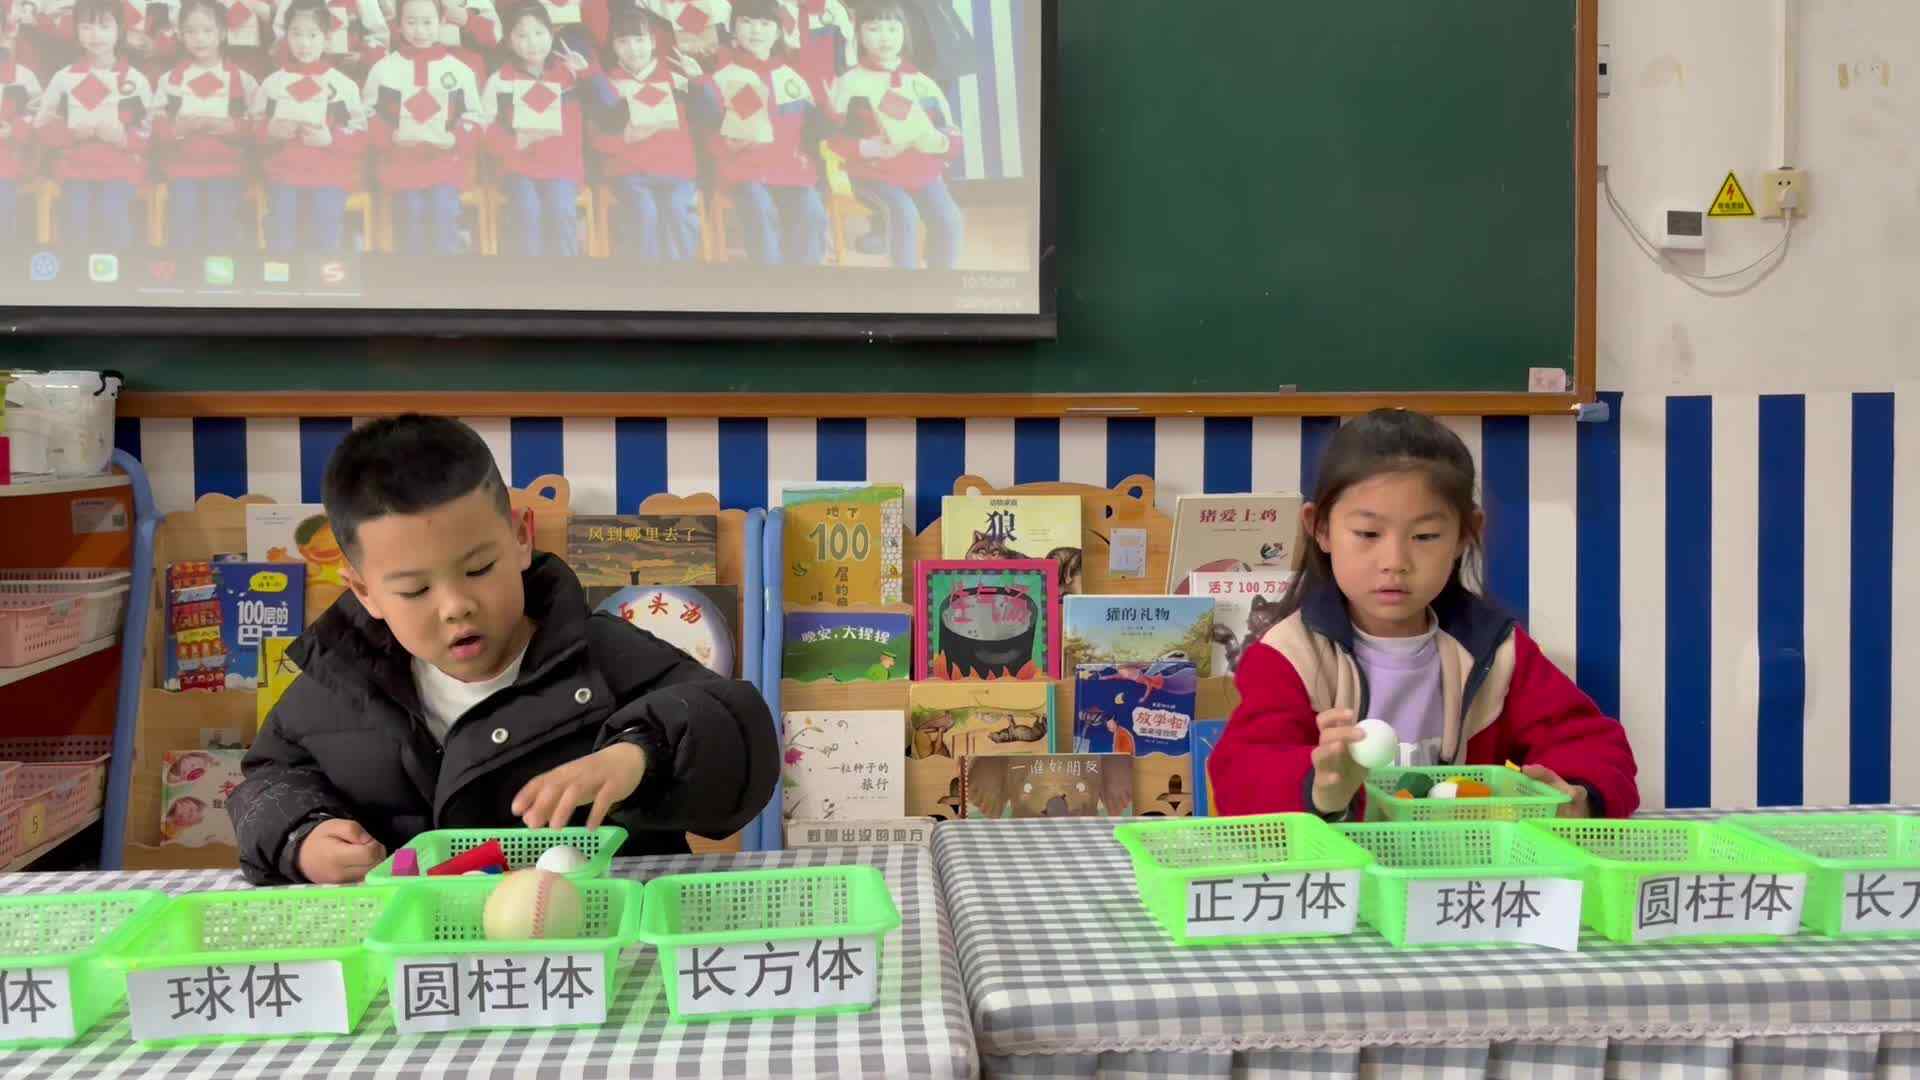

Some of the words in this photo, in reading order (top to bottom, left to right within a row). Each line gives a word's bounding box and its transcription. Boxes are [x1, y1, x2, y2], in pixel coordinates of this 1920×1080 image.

[587, 526, 697, 543] 风到哪里去了
[826, 505, 858, 518] 地下
[984, 509, 1018, 542] 狼
[1199, 506, 1279, 524] 猪爱上鸡
[808, 520, 871, 562] 100
[236, 600, 290, 626] 100层的
[1186, 871, 1349, 926] 正方体
[1436, 879, 1543, 930] 球体
[1636, 873, 1795, 930] 圆柱体
[167, 960, 304, 1023] 球体
[402, 954, 595, 1021] 圆柱体
[678, 937, 866, 1002] 长方体
